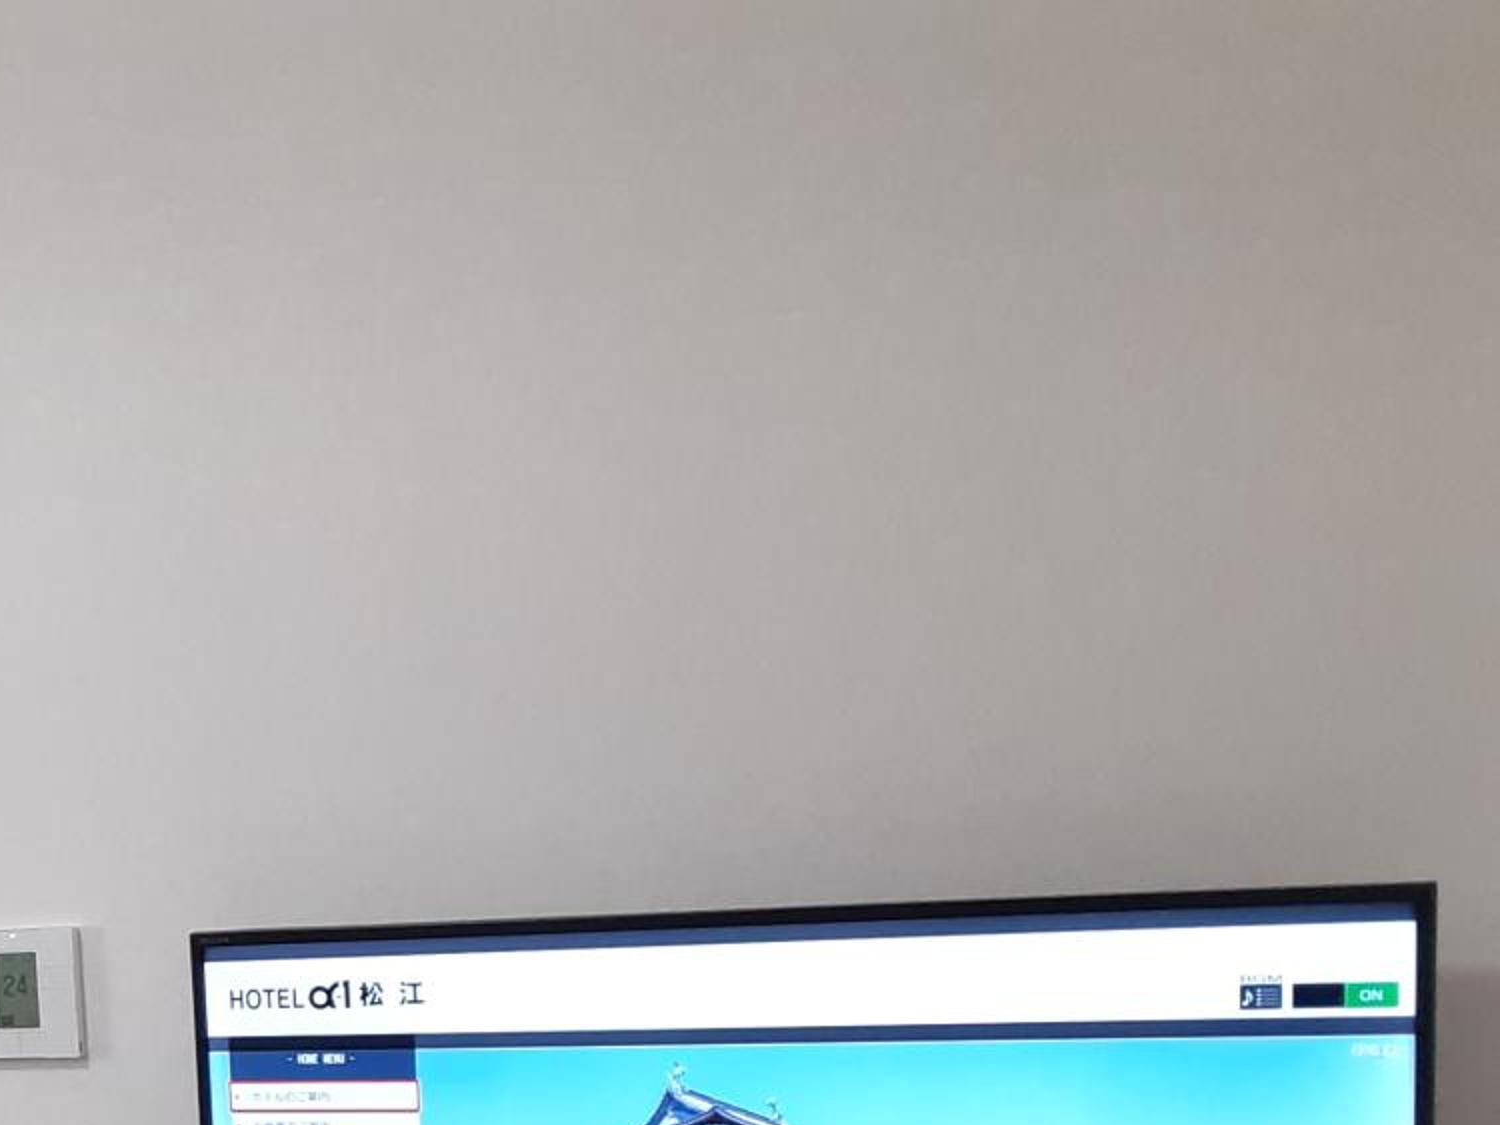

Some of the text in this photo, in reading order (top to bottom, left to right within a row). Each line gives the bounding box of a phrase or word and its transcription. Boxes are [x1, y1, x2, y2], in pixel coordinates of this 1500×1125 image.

[2, 974, 28, 998] 24
[1359, 989, 1384, 1002] ON
[229, 988, 305, 1010] HOTEL
